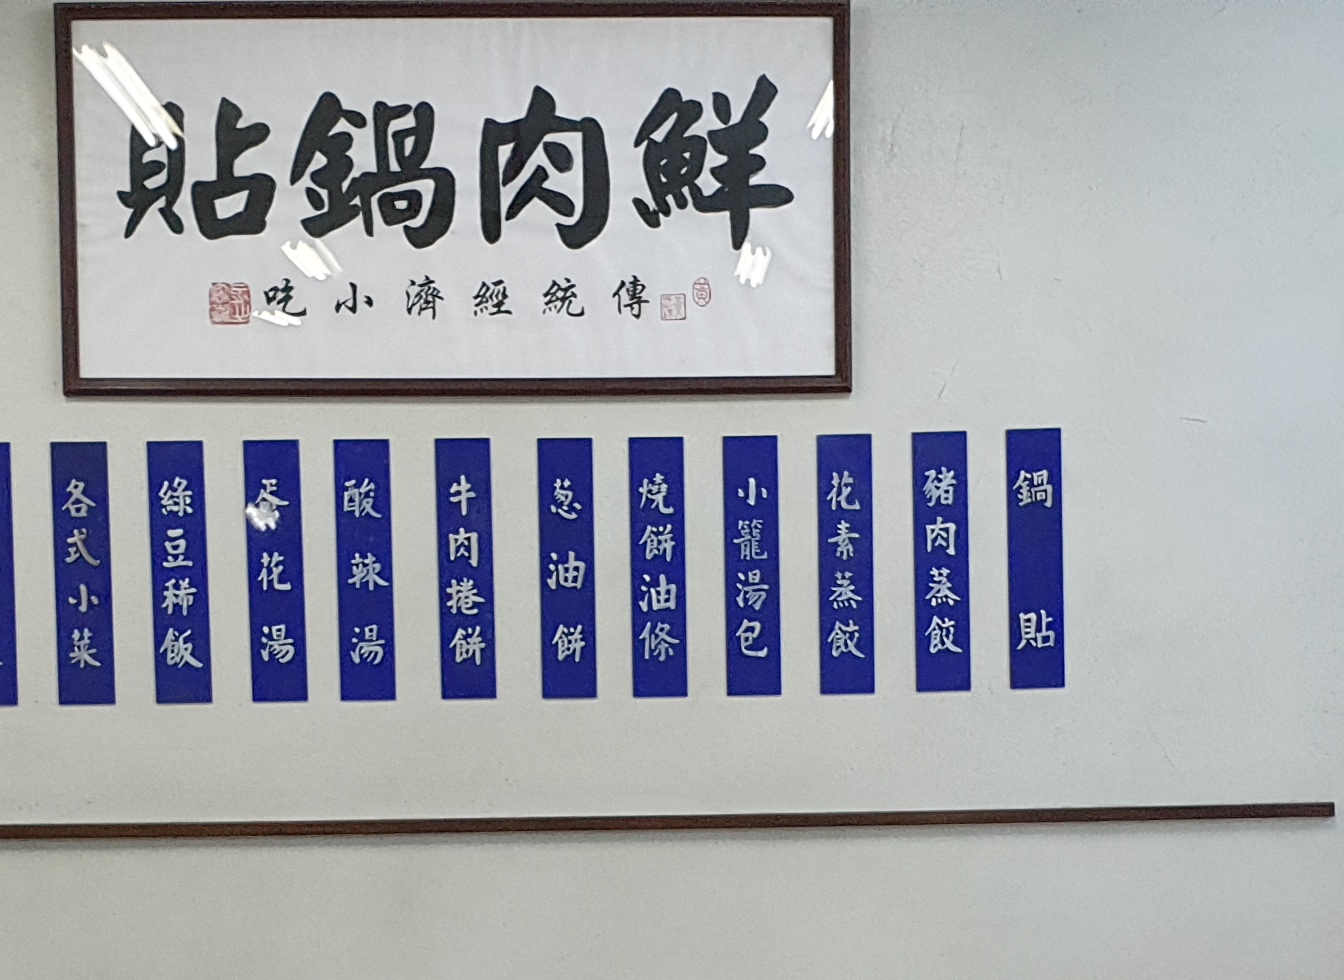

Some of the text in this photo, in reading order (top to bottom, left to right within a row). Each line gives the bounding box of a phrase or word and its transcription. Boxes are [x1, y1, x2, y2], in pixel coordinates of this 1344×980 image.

[61, 478, 102, 669] 各式小菜
[158, 477, 205, 669] 綠豆稀飯
[343, 478, 390, 666] 酸辣湯
[446, 475, 486, 667] 牛肉捲餅
[638, 472, 681, 662] 燒餅油條
[732, 477, 769, 659] 小籠湯包
[826, 471, 866, 659] 花素蒸餃
[922, 466, 964, 655] 豬肉蒸餃
[1012, 469, 1056, 651] 鍋貼
